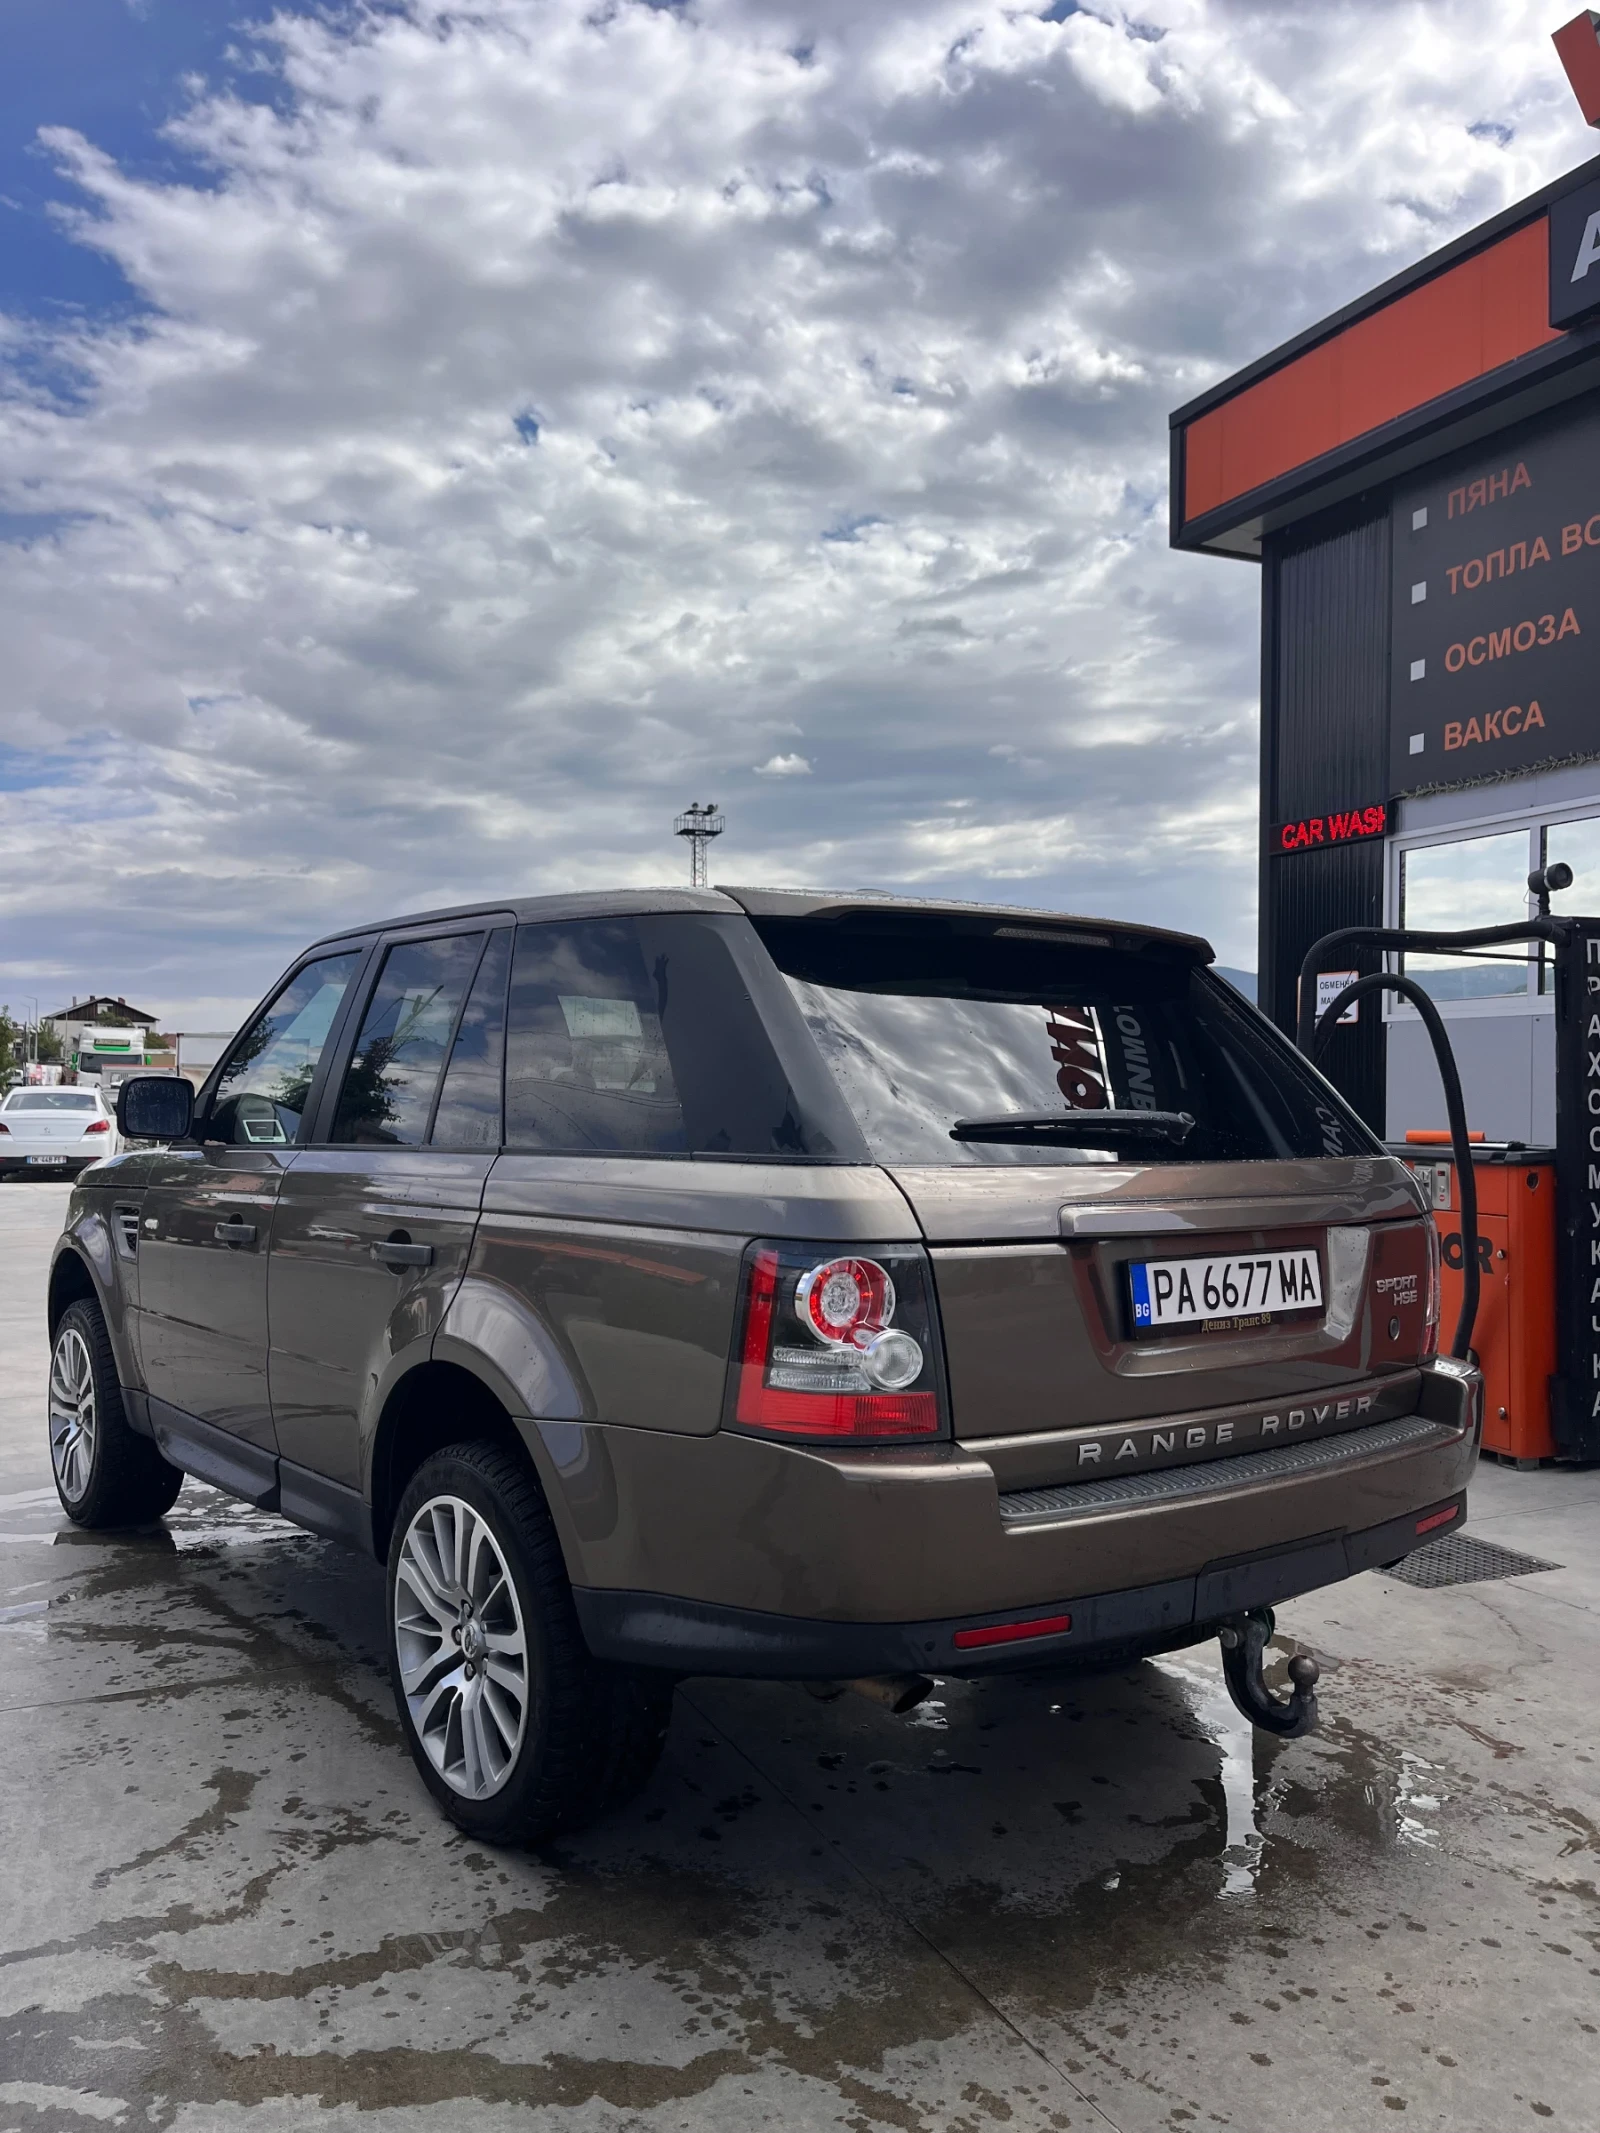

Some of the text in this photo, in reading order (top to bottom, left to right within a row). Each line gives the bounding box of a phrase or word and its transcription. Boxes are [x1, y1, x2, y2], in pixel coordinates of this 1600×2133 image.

[1447, 462, 1532, 520] ПЯНА
[1446, 536, 1551, 595] ТОПЛА
[1444, 607, 1580, 672] ОСМОЗА
[1444, 700, 1545, 751] ВАКСА
[1282, 819, 1324, 849] CAR
[1438, 1231, 1494, 1274] OR
[1153, 1257, 1316, 1317] PA 6677 MA
[1376, 1275, 1418, 1293] SPORT
[1393, 1290, 1418, 1306] HSE
[1135, 1303, 1150, 1318] BG
[1202, 1312, 1271, 1333] Дениз Транс 89
[1078, 1396, 1372, 1466] RANGE ROVER
